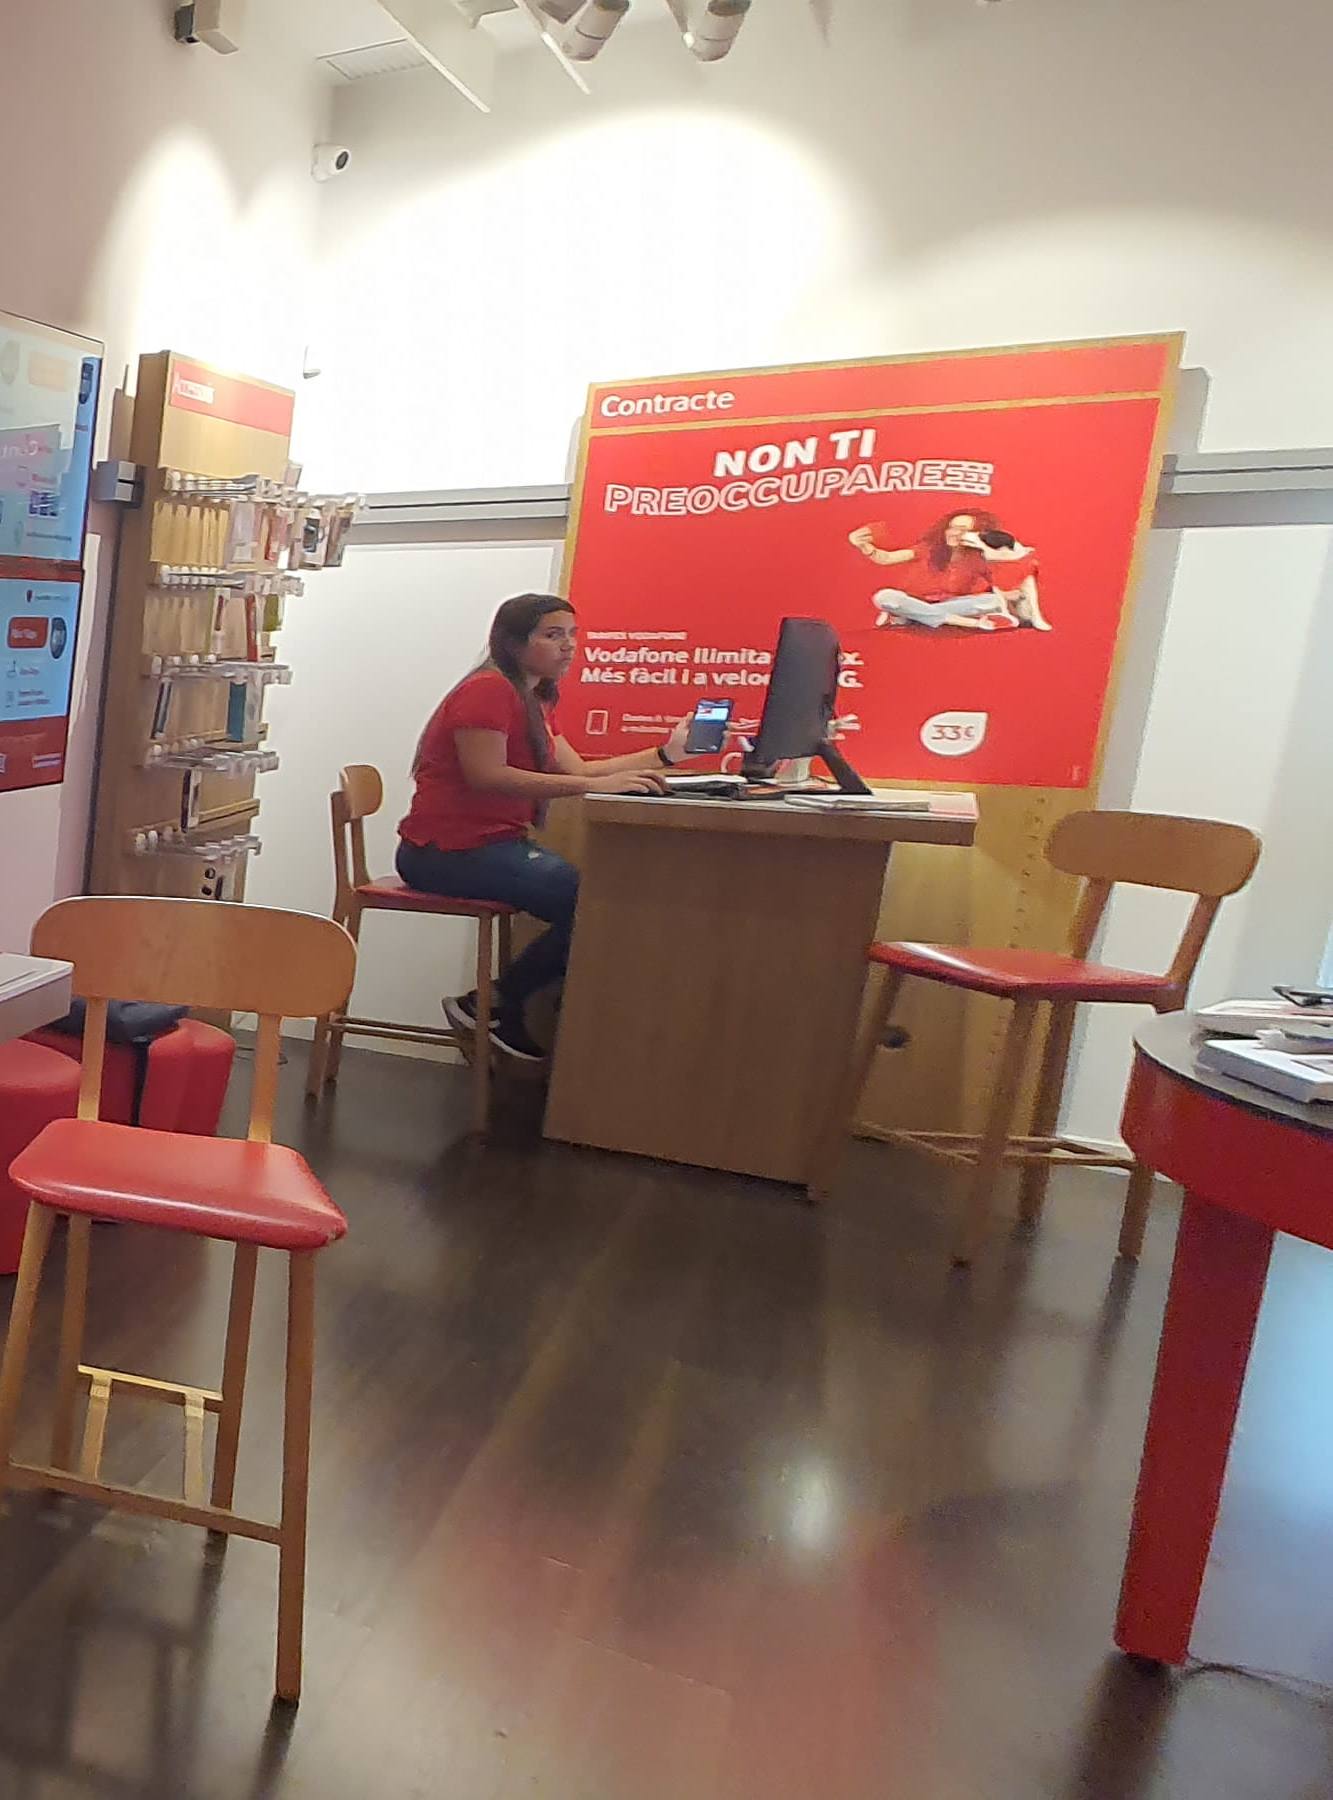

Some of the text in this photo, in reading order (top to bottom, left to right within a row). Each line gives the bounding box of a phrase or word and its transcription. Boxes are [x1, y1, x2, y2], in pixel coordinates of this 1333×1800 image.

[600, 390, 735, 418] Contracte
[714, 429, 876, 477] NON TI
[584, 646, 690, 664] Vodafone
[581, 666, 627, 684] Més
[630, 667, 678, 685] fàcil
[693, 673, 708, 686] a
[837, 671, 864, 688] G.
